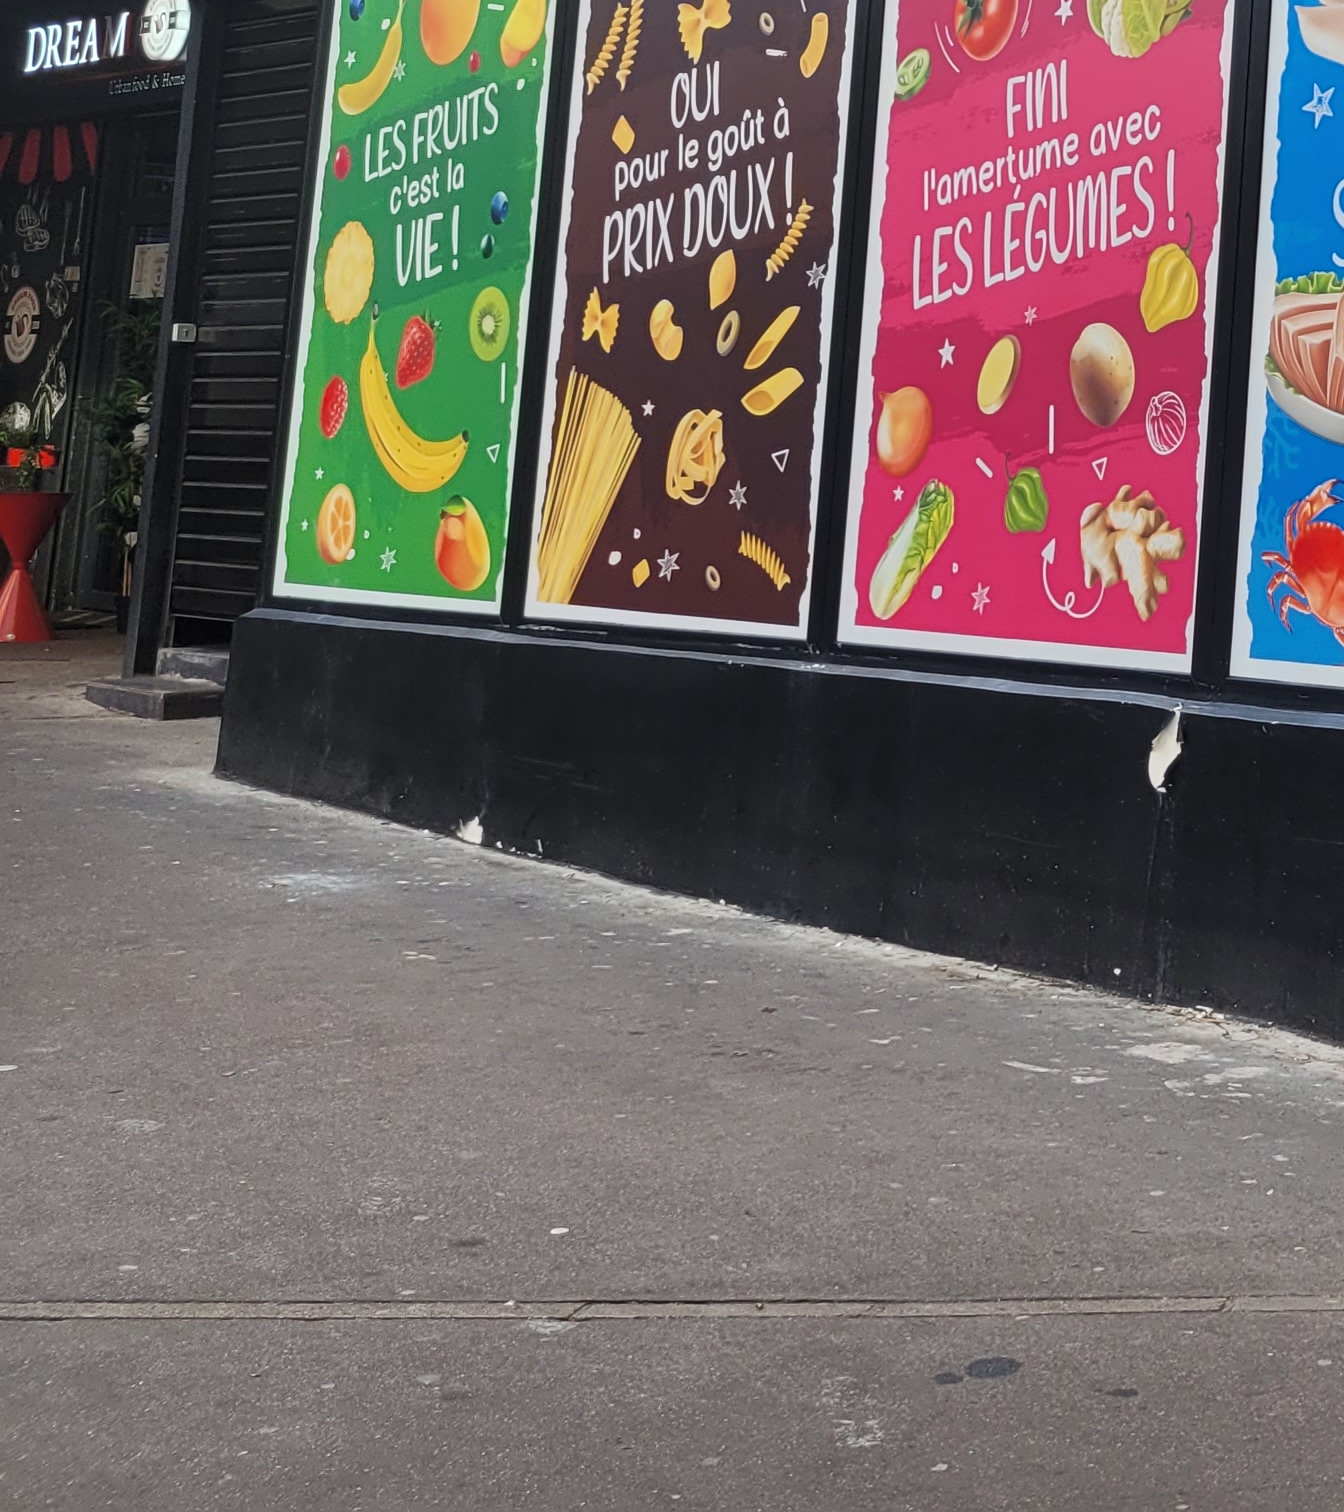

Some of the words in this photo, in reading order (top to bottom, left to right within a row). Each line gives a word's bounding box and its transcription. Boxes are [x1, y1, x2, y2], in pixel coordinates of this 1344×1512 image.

[364, 125, 407, 183] LES
[413, 83, 498, 164] FRUITS
[671, 61, 719, 128] OUI
[1007, 59, 1067, 138] FINI
[390, 167, 439, 214] c'est
[447, 161, 465, 193] la
[615, 149, 668, 201] pour
[679, 134, 699, 171] le
[708, 109, 765, 171] goût
[774, 97, 789, 139] à
[924, 133, 1078, 210] l'amertume
[1090, 105, 1160, 156] avec
[396, 213, 443, 286] VIE
[603, 193, 674, 283] PRIX
[683, 157, 774, 257] DOUX
[913, 217, 973, 309] LES
[983, 157, 1155, 287] LÉGUMES
